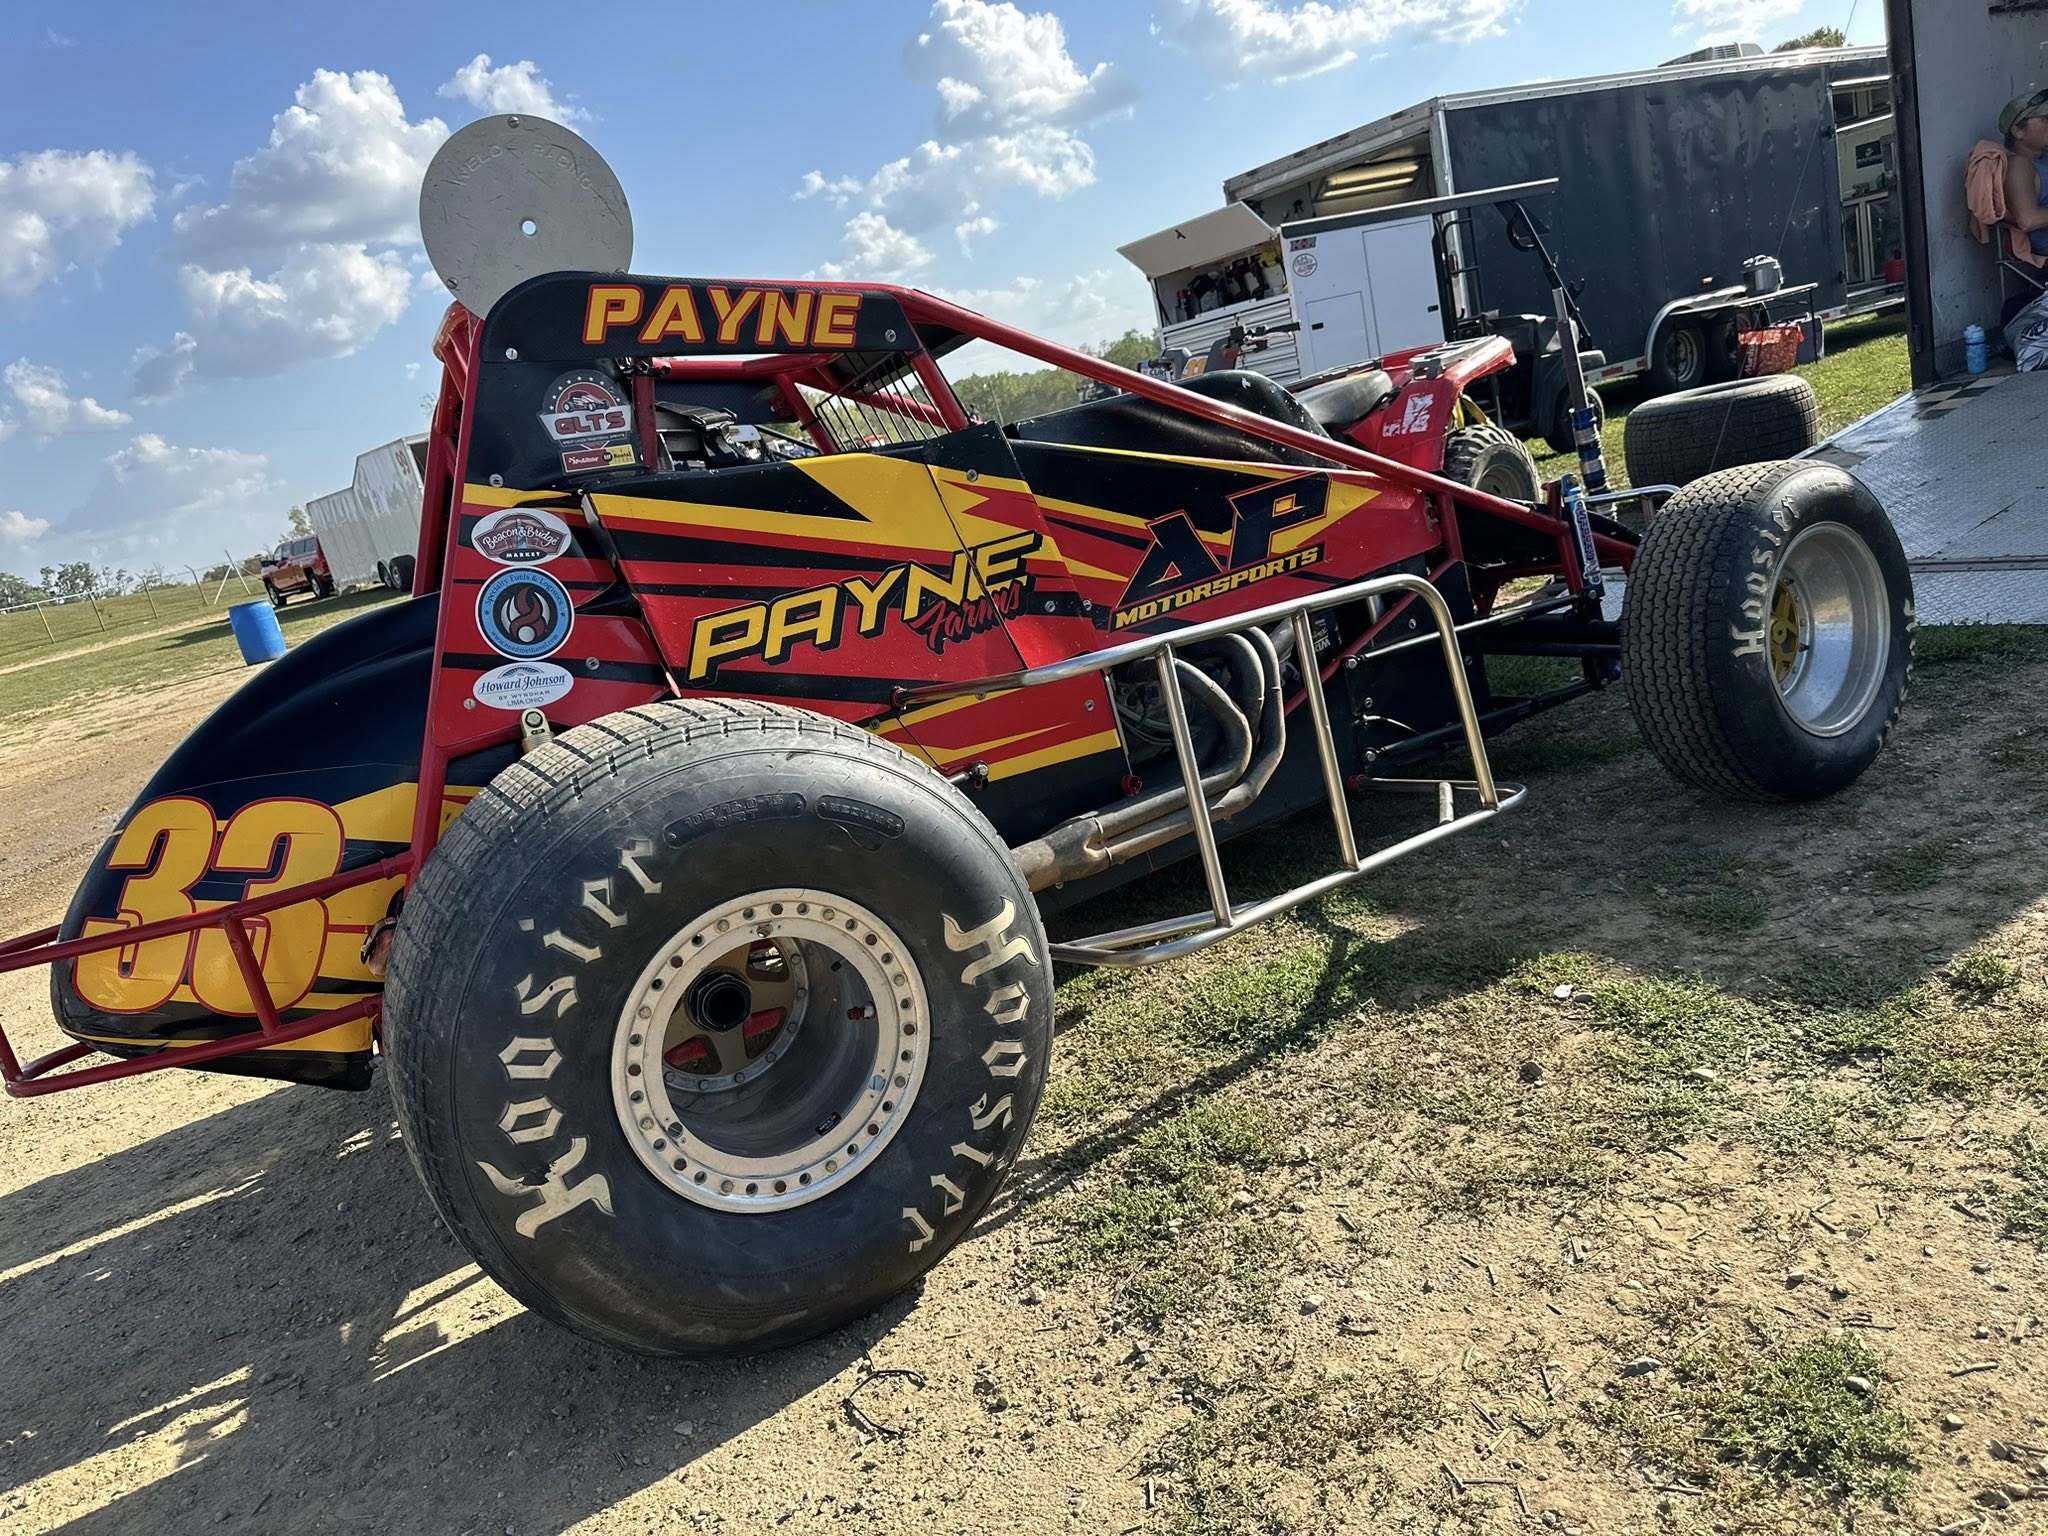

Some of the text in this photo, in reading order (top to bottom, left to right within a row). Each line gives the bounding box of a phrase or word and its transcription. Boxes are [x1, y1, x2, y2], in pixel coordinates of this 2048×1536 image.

[450, 144, 502, 186] WELD
[582, 284, 864, 349] PAYNE
[554, 410, 626, 435] GLTS
[482, 527, 518, 550] Beacon
[525, 525, 560, 547] Bridge
[687, 531, 1042, 683] PAYNE
[912, 580, 1025, 652] Farms
[1114, 545, 1320, 631] MOTORSPORTS
[478, 674, 566, 695] Howard Johnson
[507, 699, 525, 707] LIMA
[511, 689, 551, 700] WYNDHAM
[71, 795, 345, 1018] 33
[475, 838, 664, 1240] Hoosier
[901, 896, 1039, 1253] Hoosier
